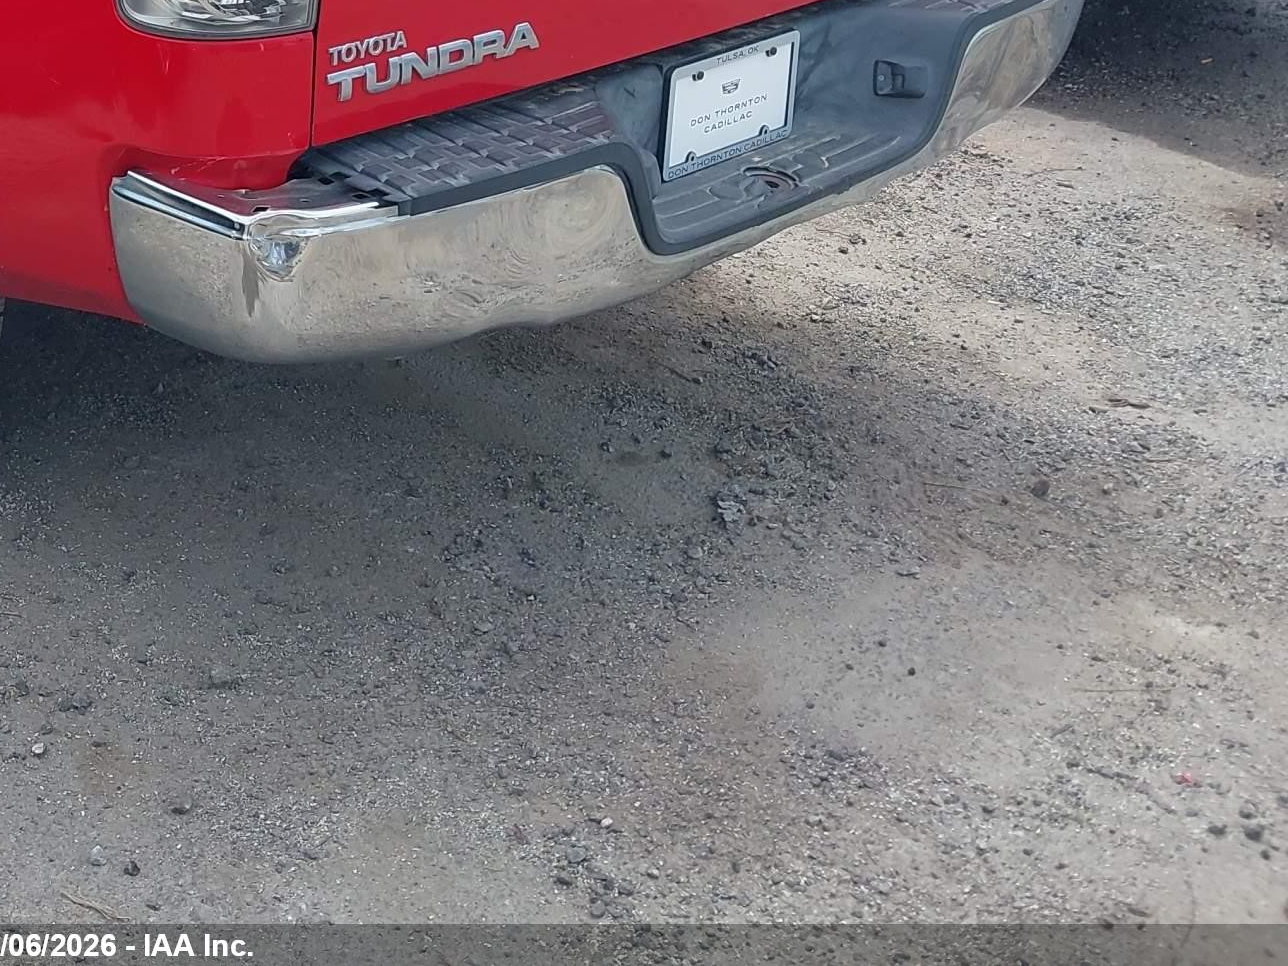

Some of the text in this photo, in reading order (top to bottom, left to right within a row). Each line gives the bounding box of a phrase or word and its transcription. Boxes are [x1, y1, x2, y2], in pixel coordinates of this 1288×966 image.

[327, 30, 408, 66] TOYOTA
[327, 22, 540, 102] TUNDRA
[747, 45, 760, 54] OK
[690, 93, 768, 127] DON THORNTON
[703, 111, 753, 134] CADILLAC
[667, 129, 788, 179] DON THORNTON CADILLAC
